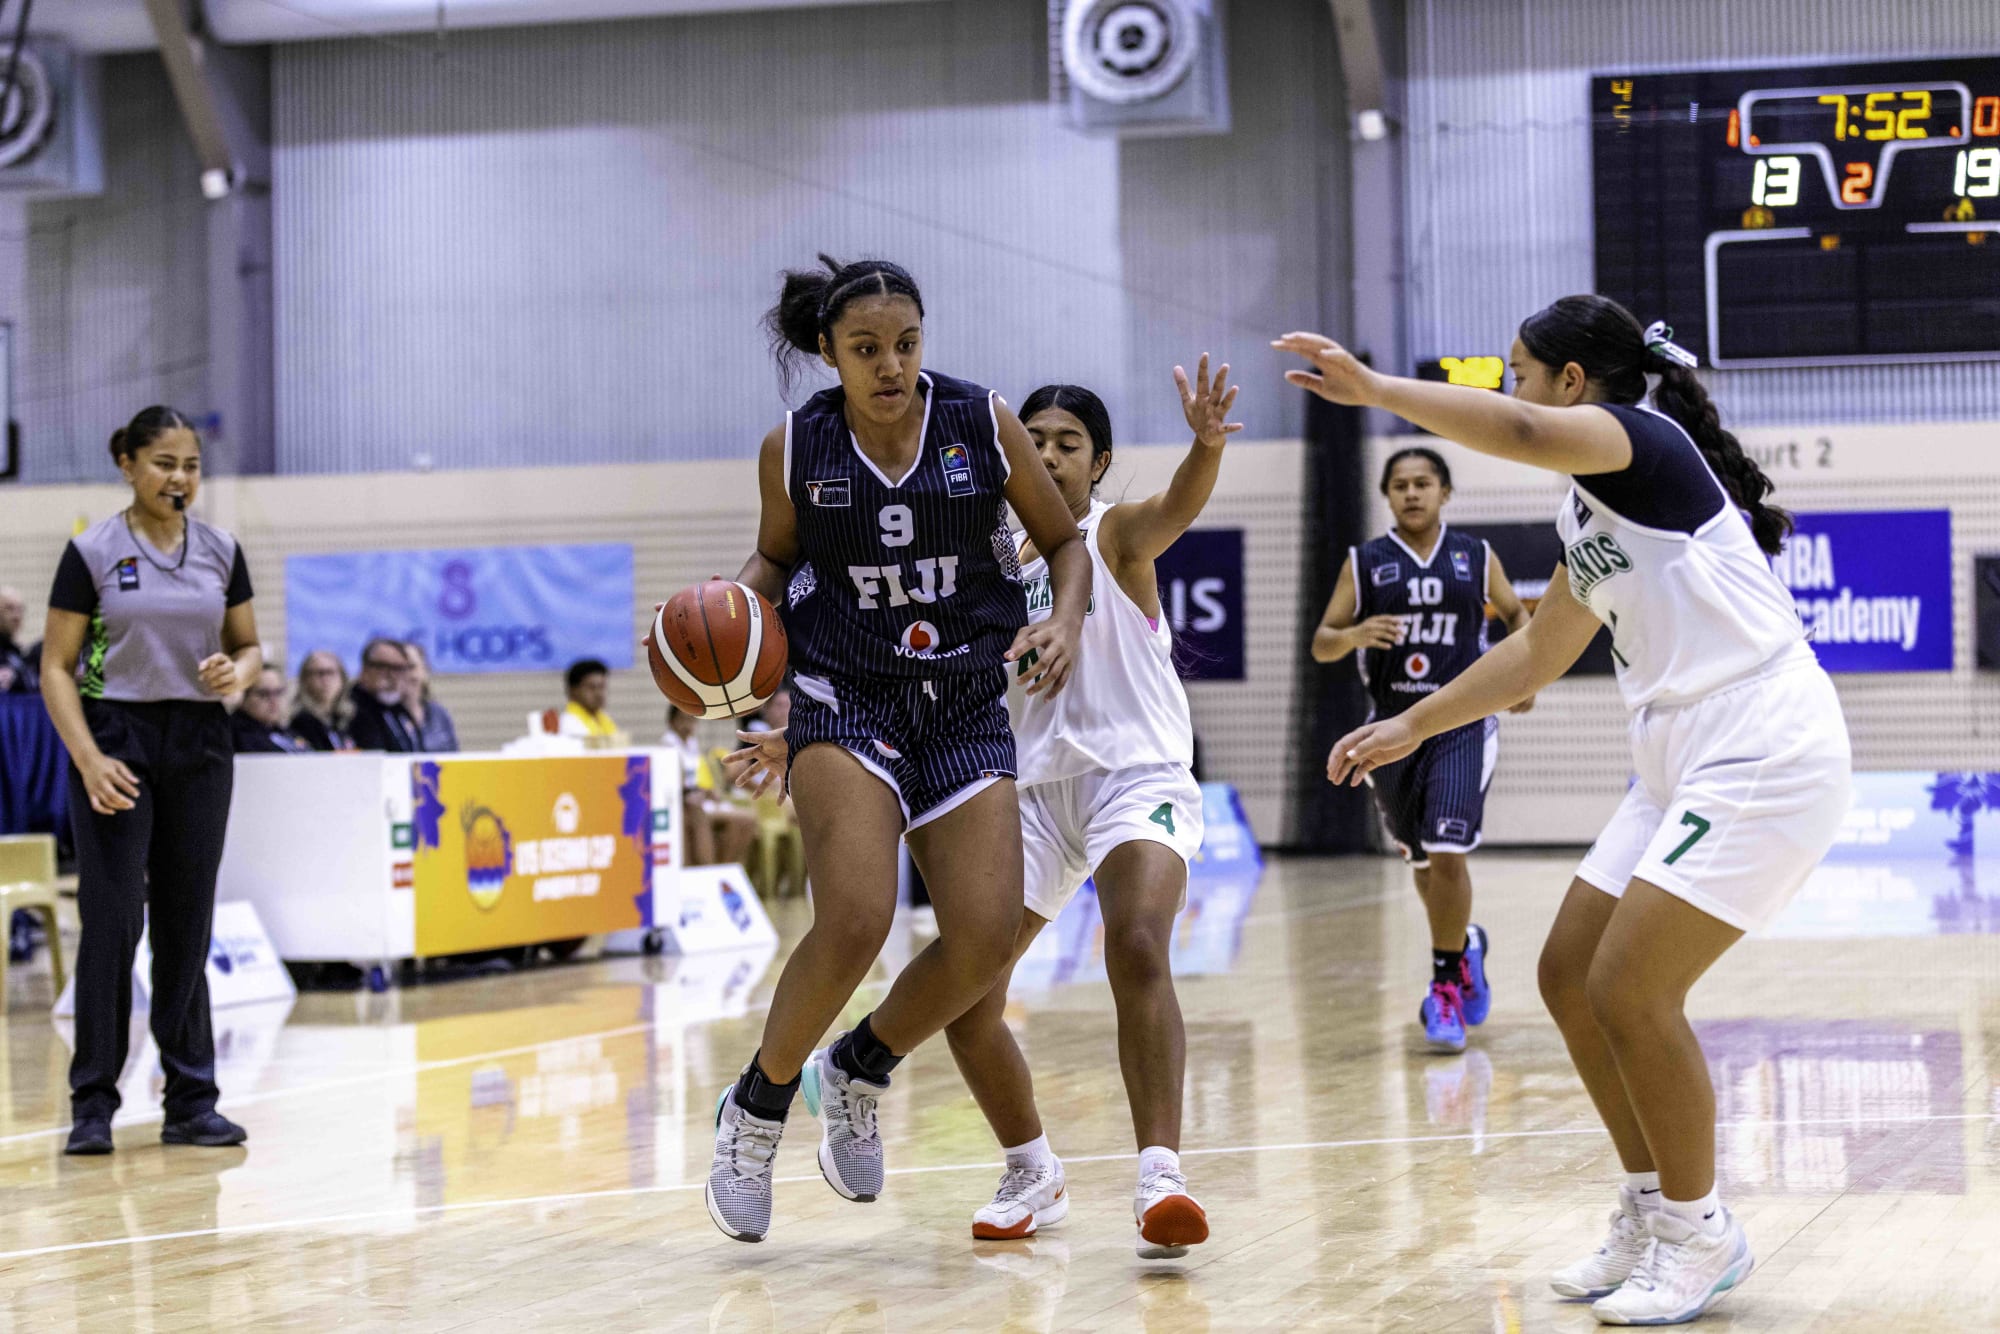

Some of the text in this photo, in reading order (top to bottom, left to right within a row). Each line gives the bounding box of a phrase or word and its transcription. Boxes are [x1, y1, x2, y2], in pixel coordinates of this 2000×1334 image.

[1818, 90, 1932, 141] 7:52
[1752, 156, 1801, 206] 13
[1841, 162, 1873, 204] 2
[1953, 147, 2000, 197] 19
[1816, 437, 1833, 468] 2
[950, 472, 968, 483] FIBA
[879, 504, 914, 548] 9
[848, 555, 959, 610] FIJI
[1407, 577, 1443, 605] 10
[1394, 613, 1458, 645] FIJI
[1796, 587, 1921, 651] cademy
[1148, 802, 1176, 837] 4
[1662, 810, 1711, 867] 7
